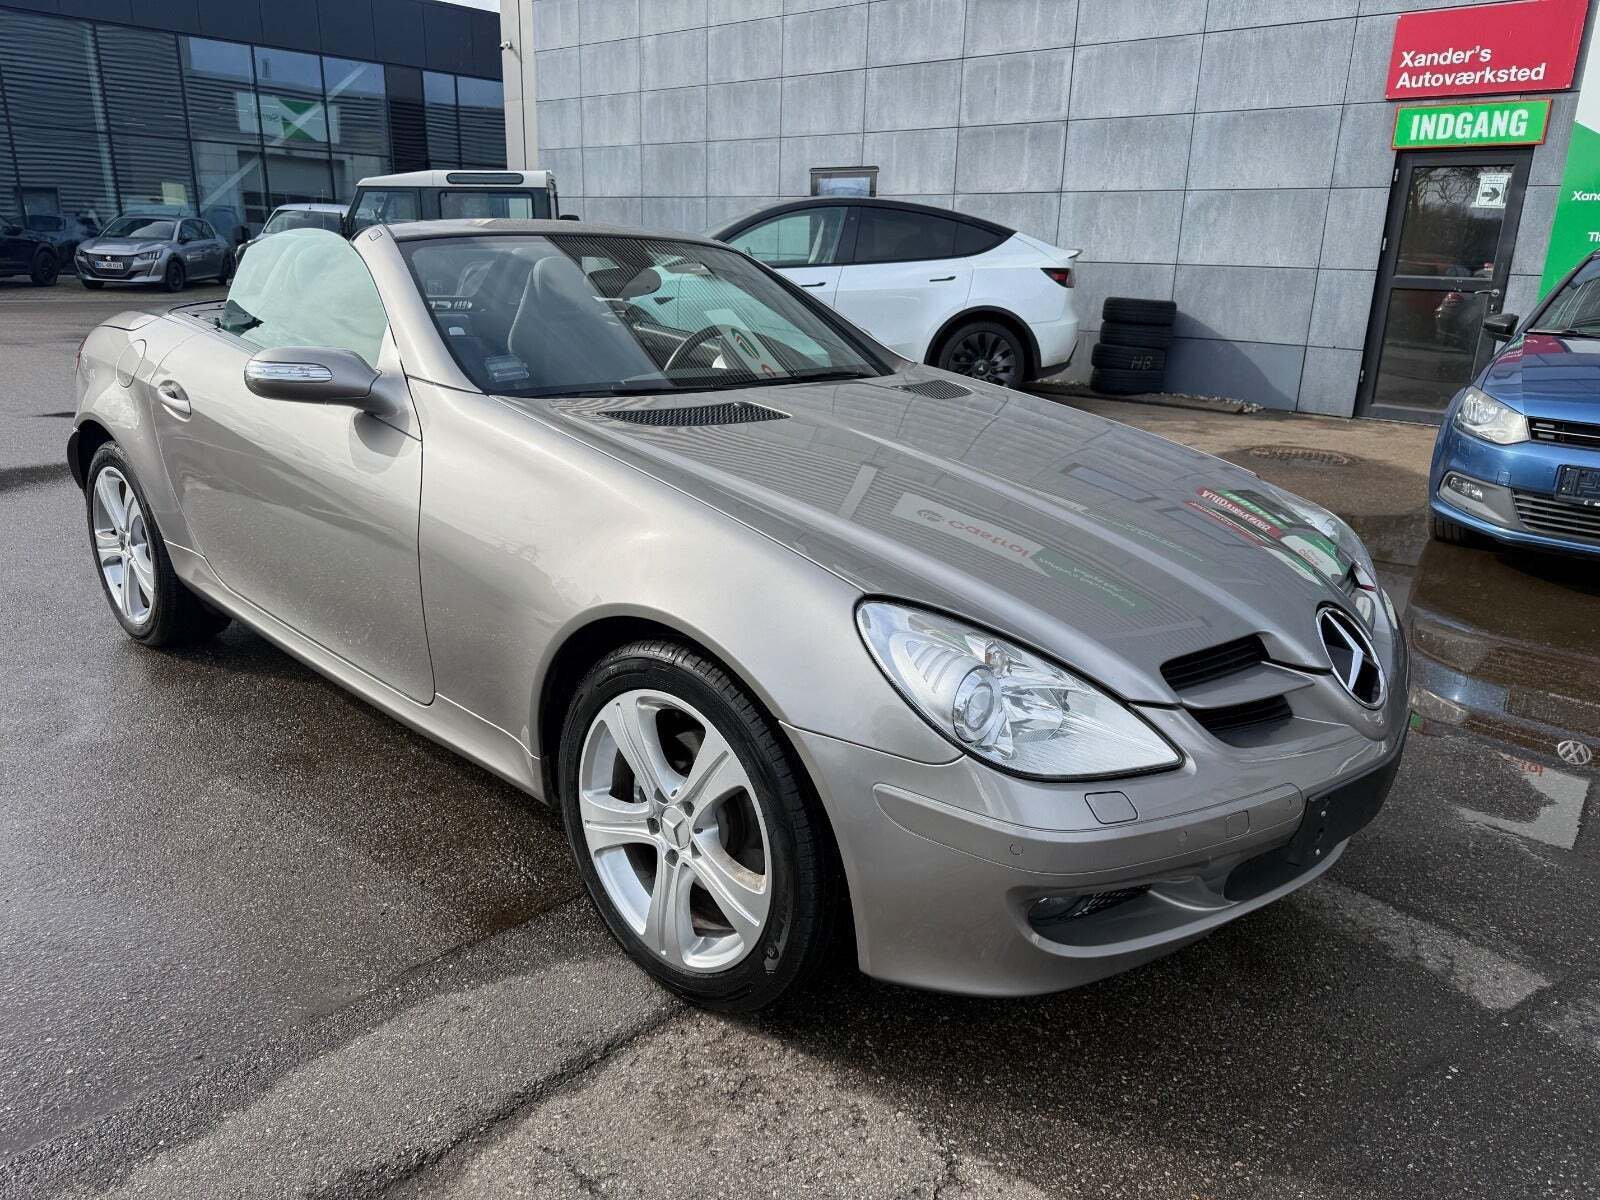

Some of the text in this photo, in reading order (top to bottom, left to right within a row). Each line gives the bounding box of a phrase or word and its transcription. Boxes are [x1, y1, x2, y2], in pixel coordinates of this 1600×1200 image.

[1400, 45, 1492, 68] Xander's
[1395, 62, 1547, 89] Autoværksted
[1410, 108, 1529, 141] INDGANG
